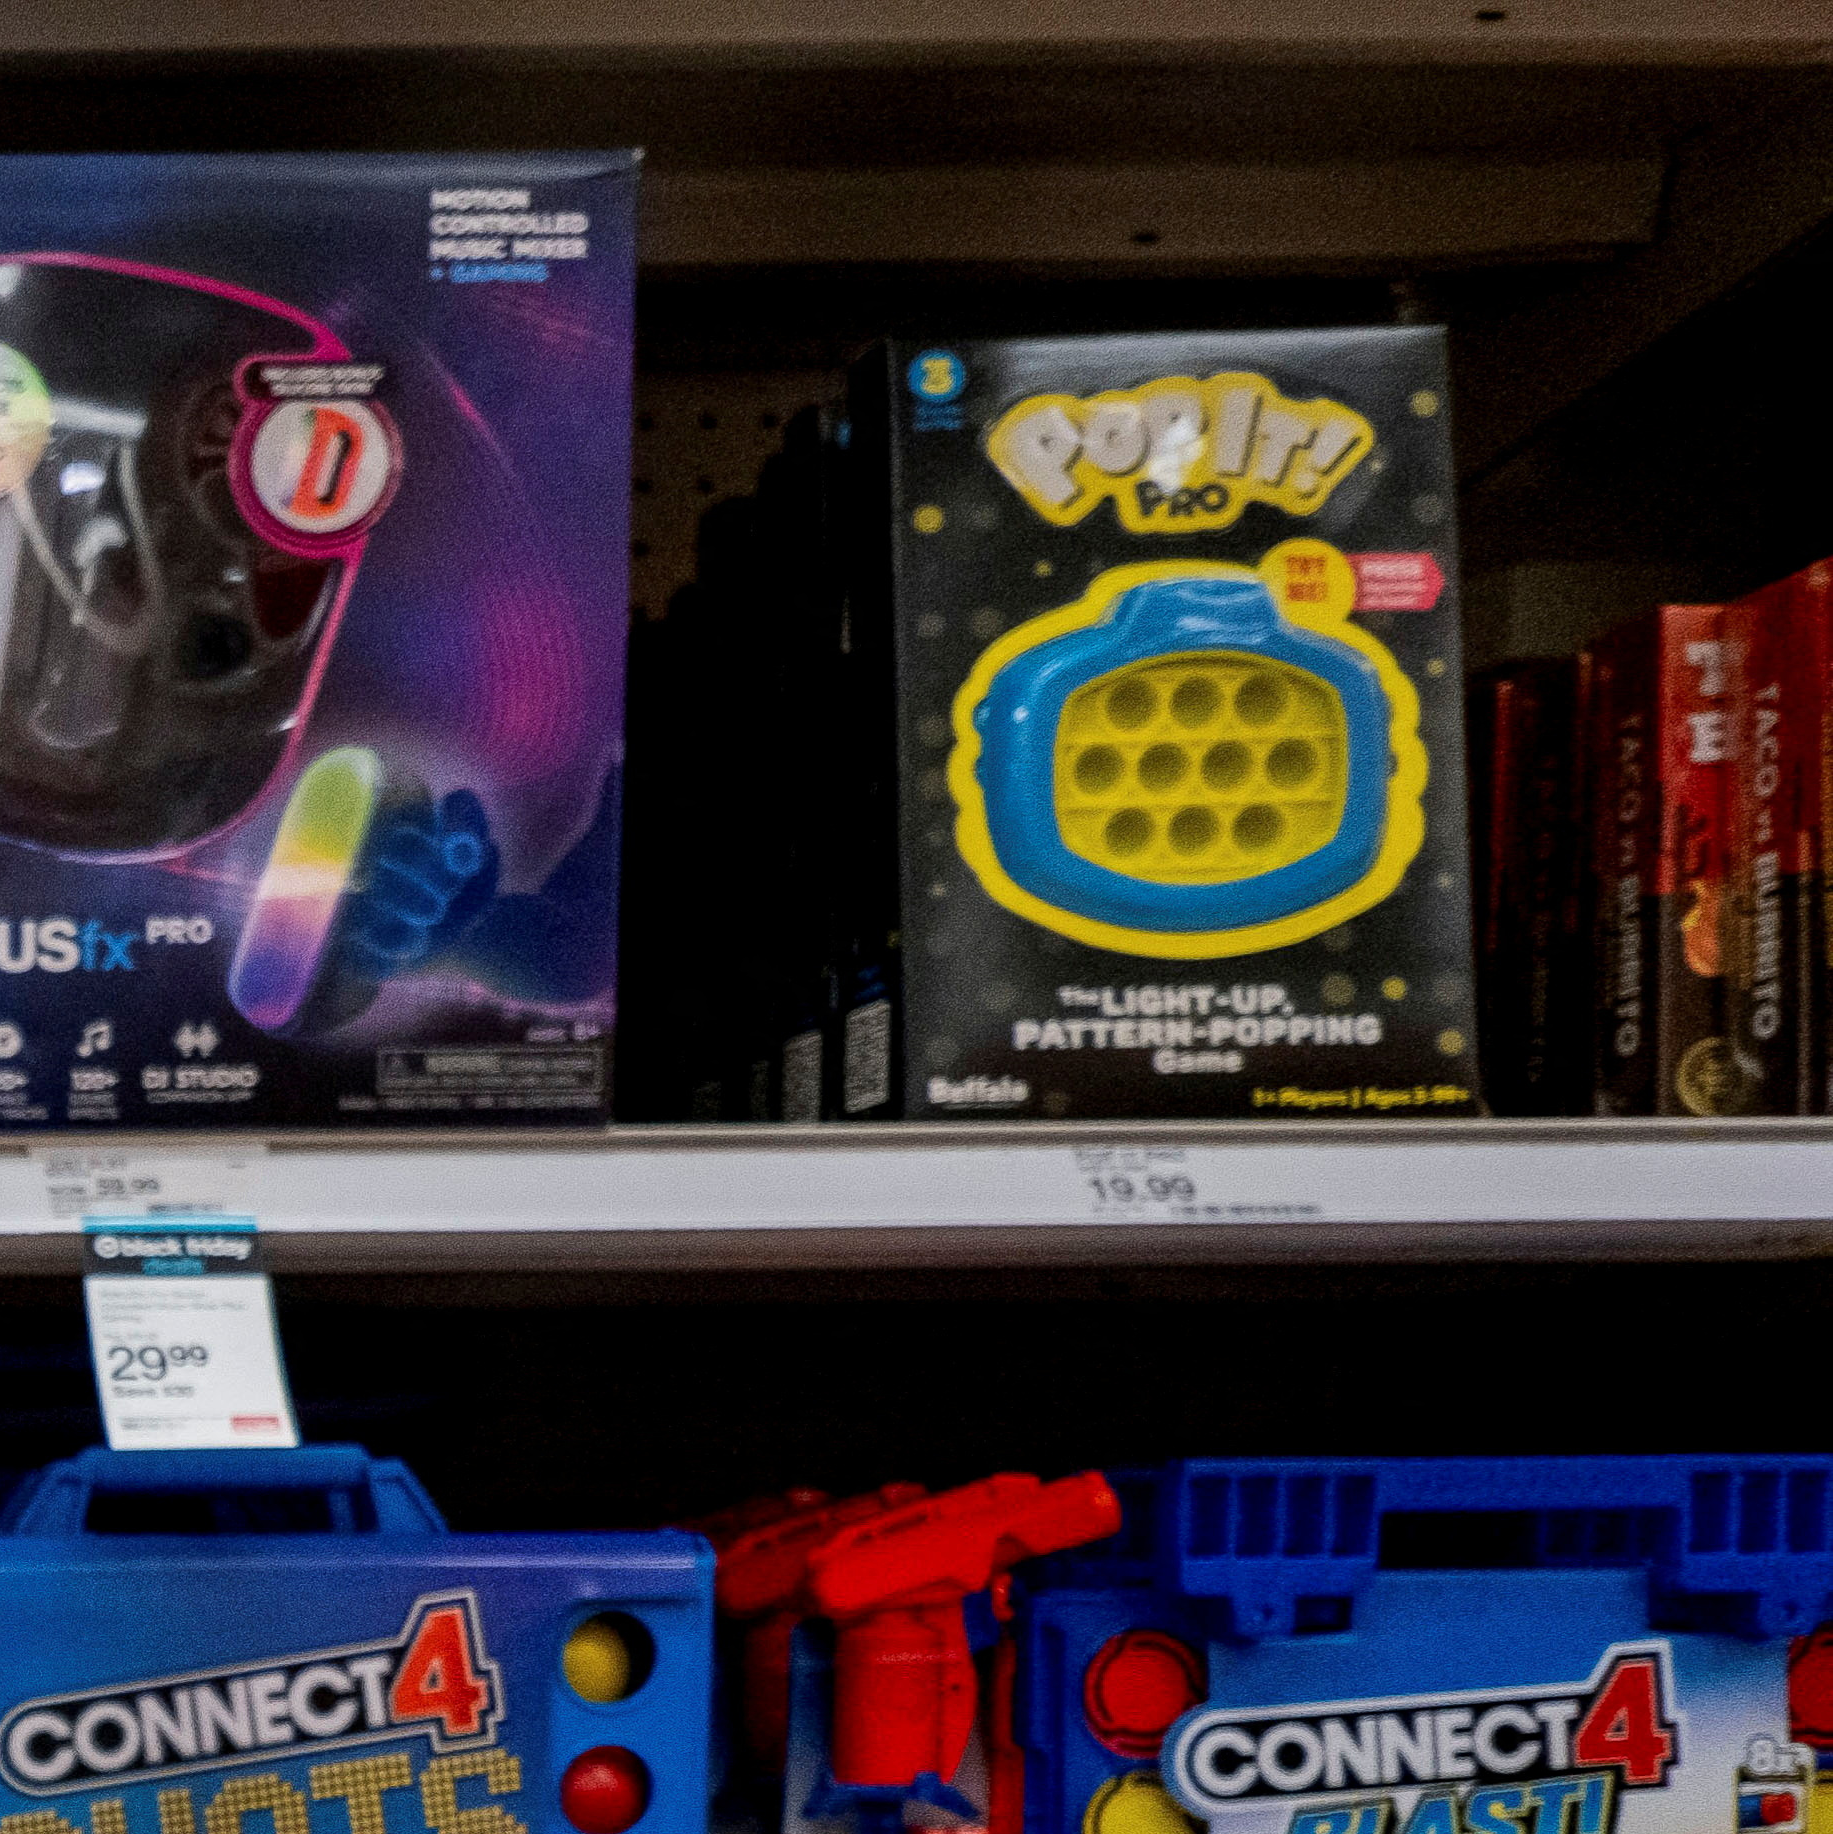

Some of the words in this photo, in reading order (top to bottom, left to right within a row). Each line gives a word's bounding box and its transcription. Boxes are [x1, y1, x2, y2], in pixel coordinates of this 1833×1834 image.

[997, 400, 1211, 512] POP
[1136, 480, 1231, 522] PRO
[145, 917, 212, 946] PRO
[1751, 850, 1782, 1042] BURRITO
[1012, 1014, 1383, 1050] PATTERN-POPPING
[1088, 1174, 1196, 1203] 19.99
[7, 1658, 398, 1781] CONNECT
[391, 1607, 490, 1737] 4
[1194, 1701, 1576, 1796] CONNECT
[1574, 1655, 1678, 1784] 4
